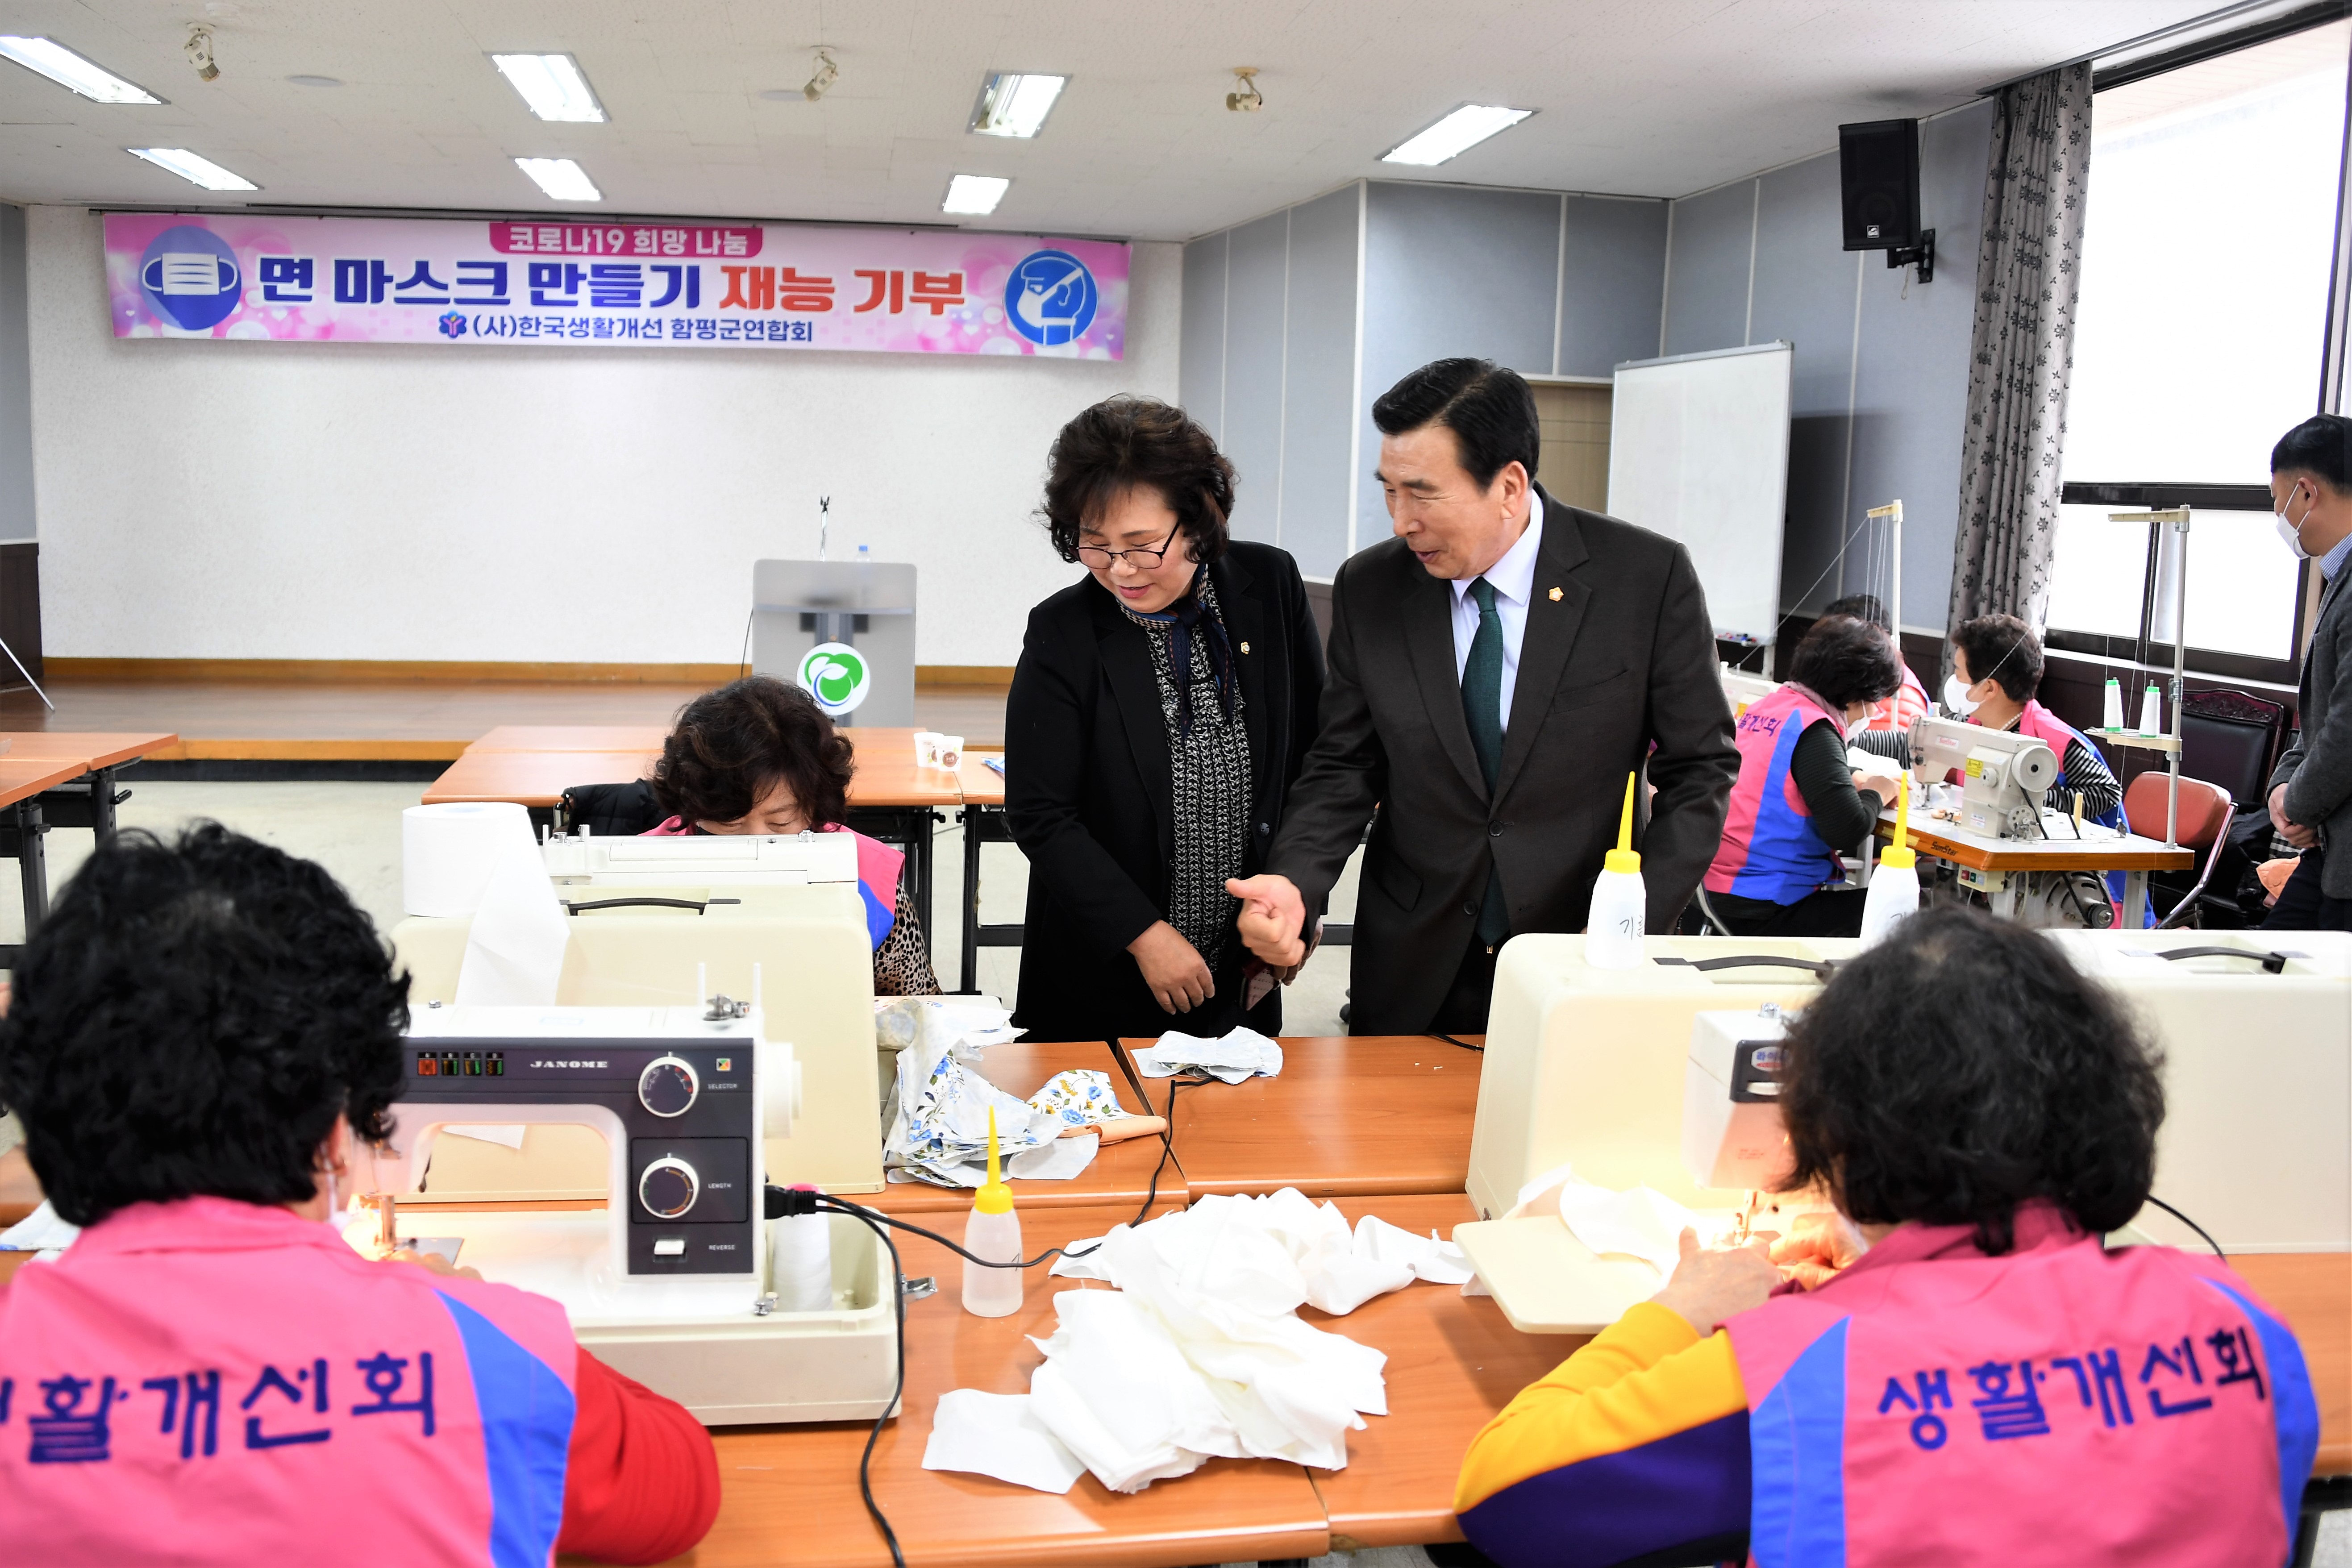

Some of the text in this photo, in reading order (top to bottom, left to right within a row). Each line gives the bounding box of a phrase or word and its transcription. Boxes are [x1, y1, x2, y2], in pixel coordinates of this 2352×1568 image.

[509, 226, 747, 256] 코로나19 희망 나눔
[260, 258, 965, 316] 면 마스크 만들기 재능 기부
[473, 314, 812, 342] (사)한국생활개선 함평군연합회
[1931, 841, 1959, 857] SunStar
[0, 1352, 436, 1464] 활개선회
[1877, 1325, 2266, 1452] 생활개선회
